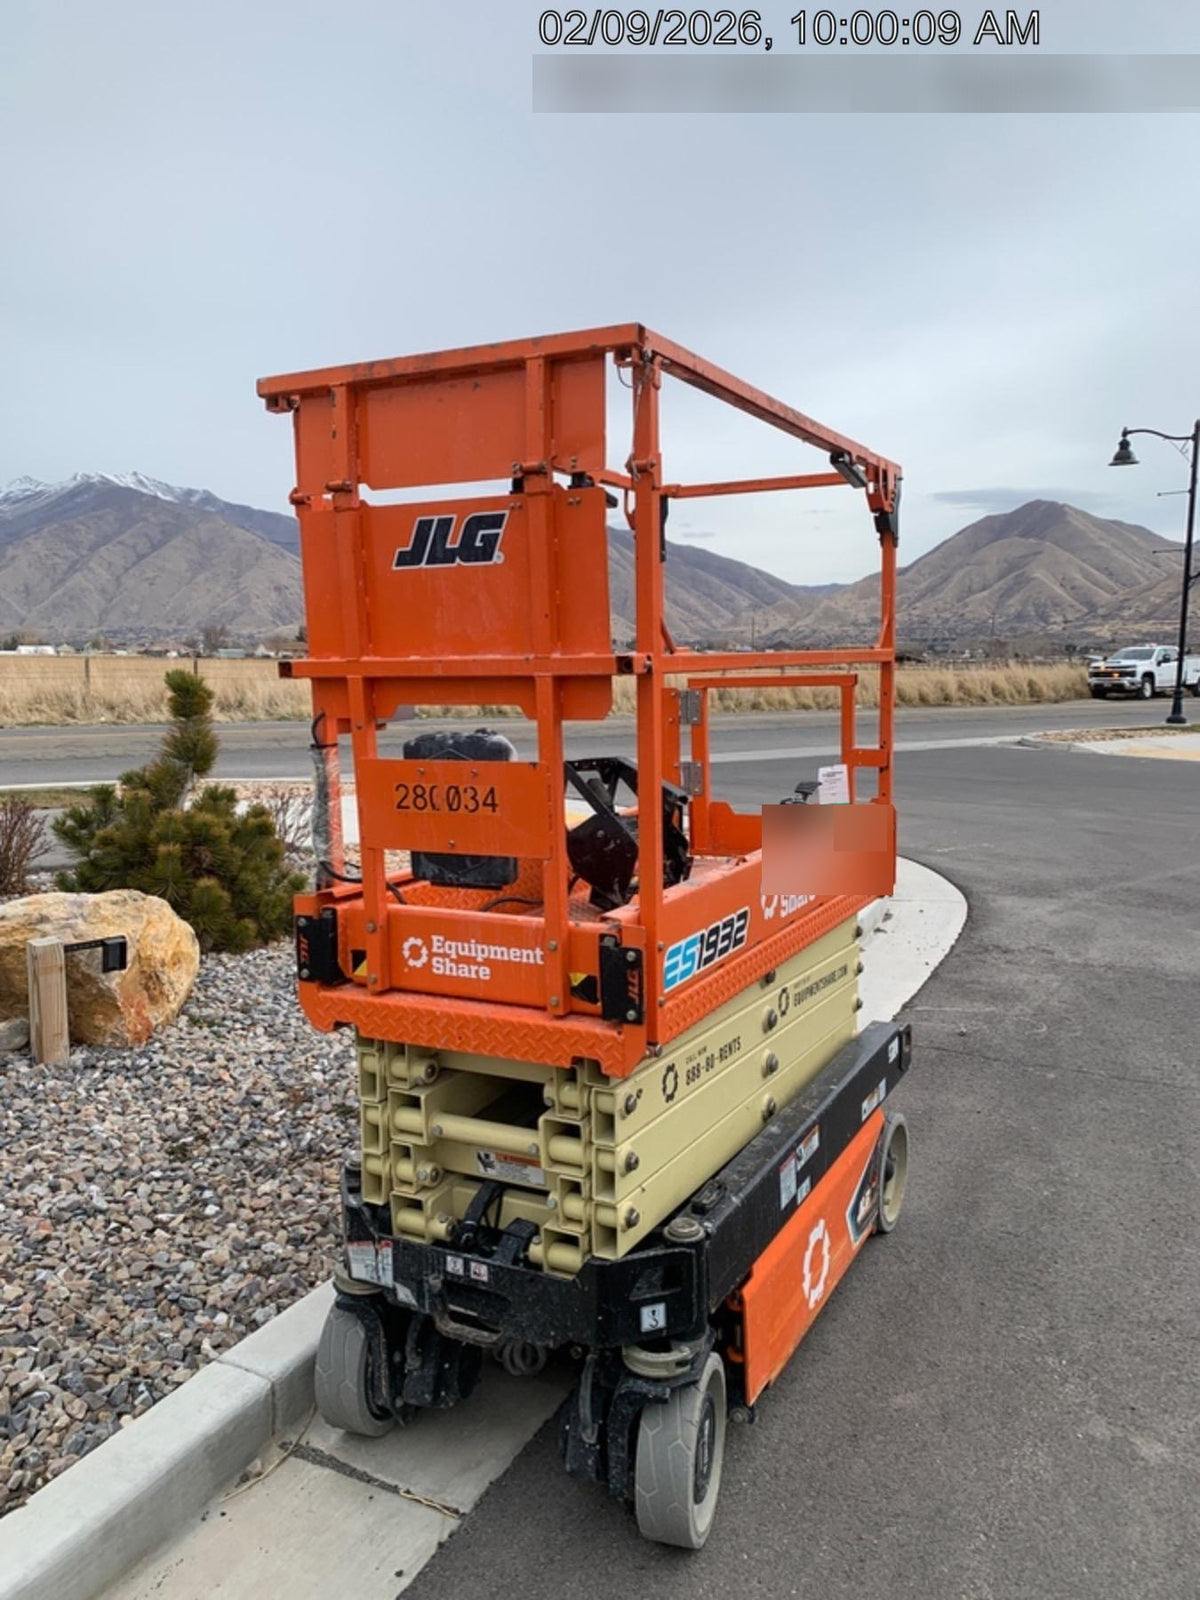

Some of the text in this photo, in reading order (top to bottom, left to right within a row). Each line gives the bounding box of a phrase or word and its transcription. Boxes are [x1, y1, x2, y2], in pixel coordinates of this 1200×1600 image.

[392, 510, 509, 570] JLG
[430, 934, 545, 965] Equipment
[431, 956, 491, 980] Share
[663, 906, 750, 993] ES1932
[626, 967, 639, 1005] JLG
